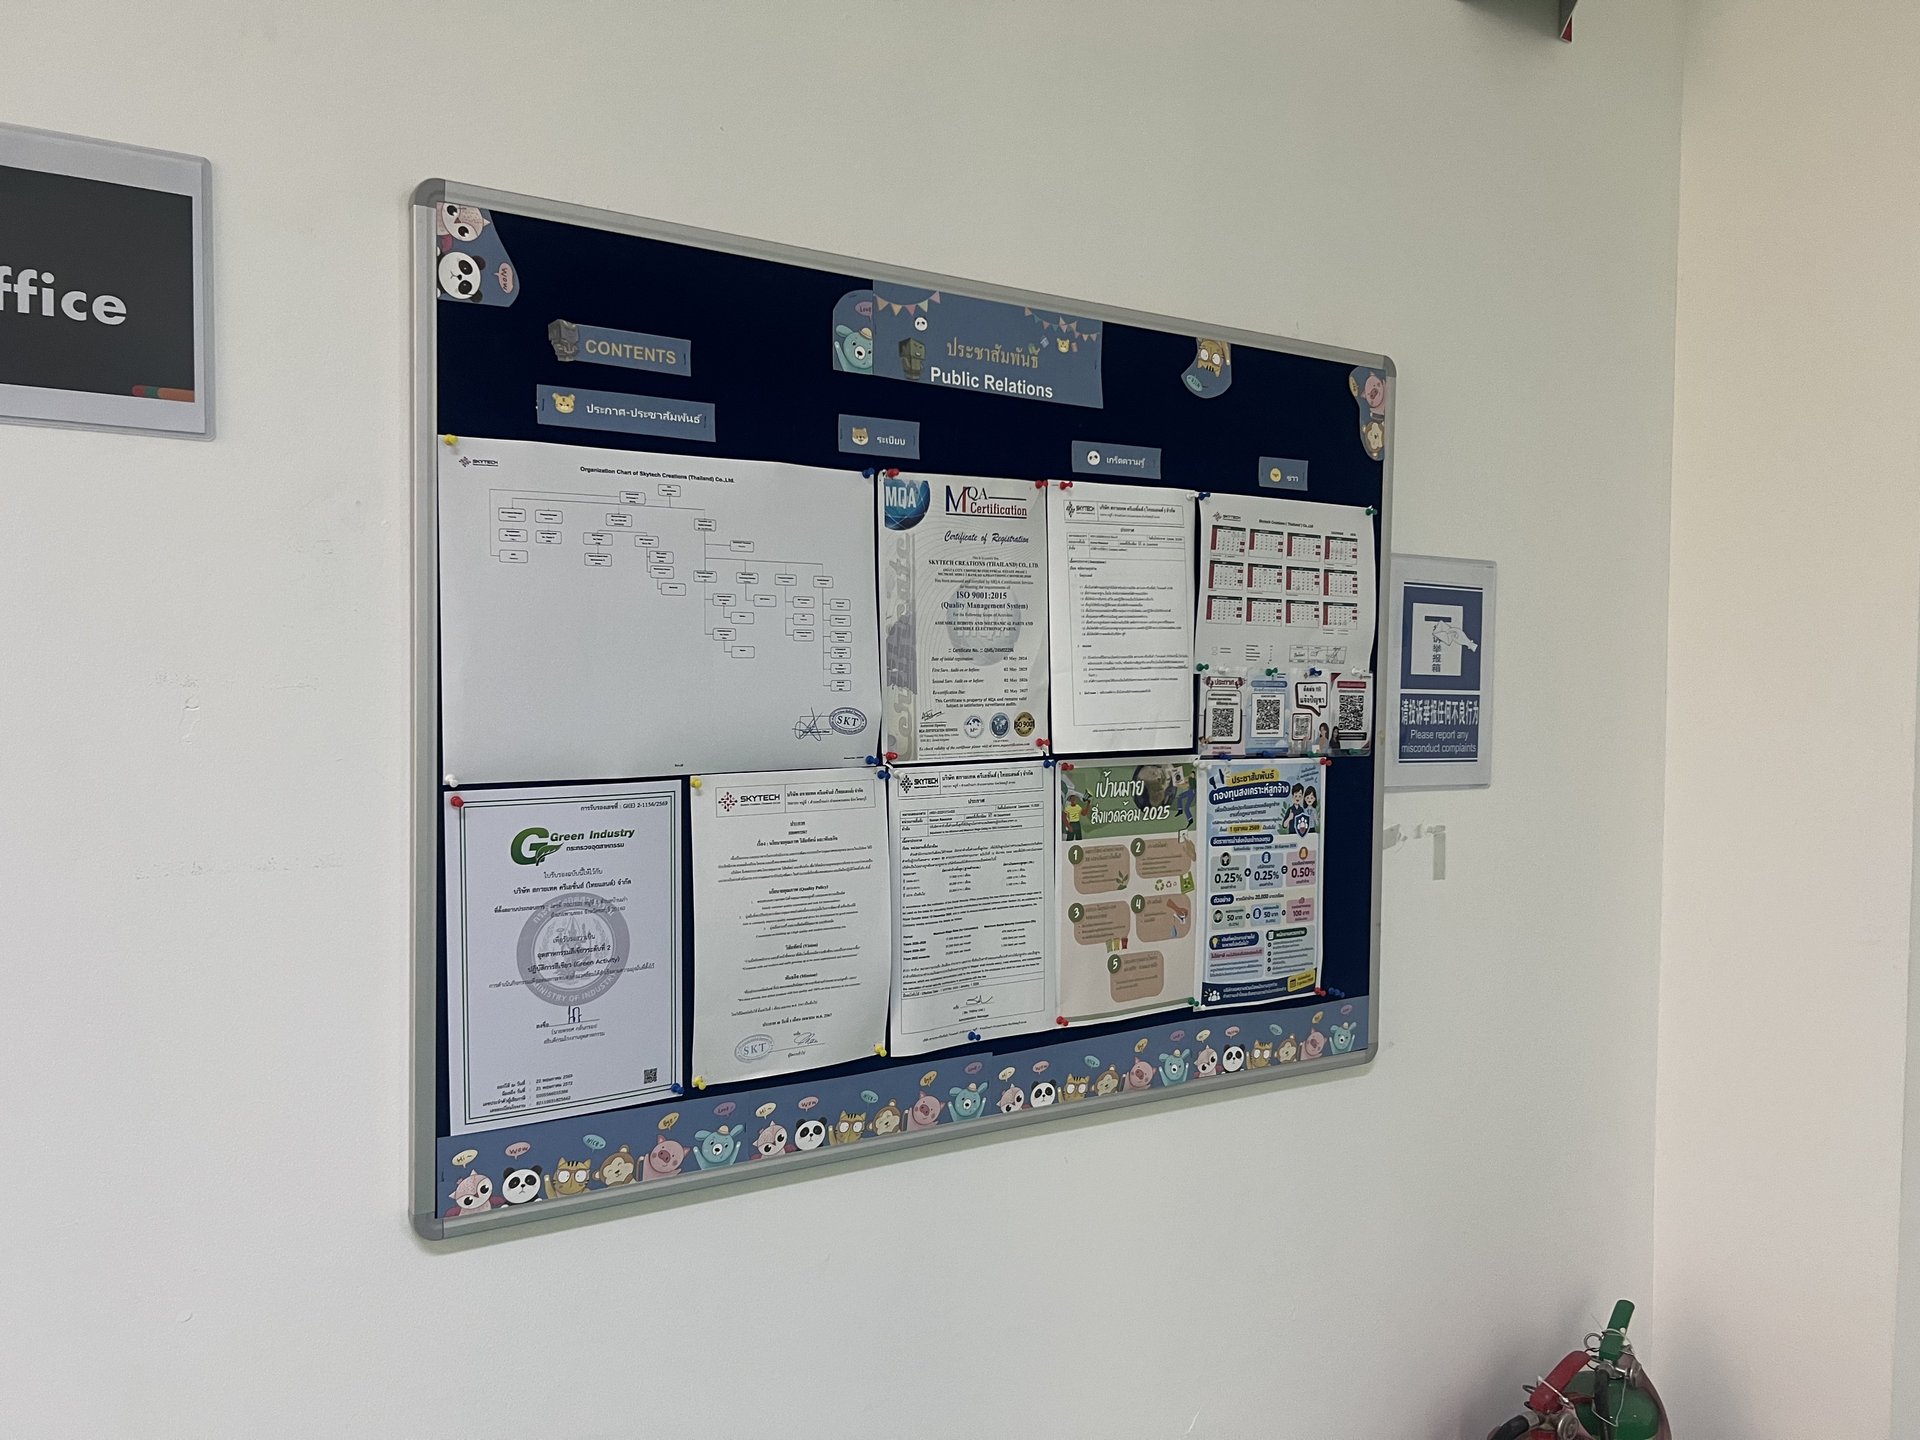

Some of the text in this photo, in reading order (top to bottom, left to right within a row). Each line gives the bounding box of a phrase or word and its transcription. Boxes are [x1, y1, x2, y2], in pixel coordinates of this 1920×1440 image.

[584, 338, 677, 366] CONTENTS
[946, 336, 1040, 369] ประชาสัมพันธ์
[930, 366, 1054, 399] Public Relations
[586, 402, 703, 425] ประกาศ-ประชาสัมพันธ์
[580, 466, 616, 474] Organization
[640, 470, 661, 479] Skytech
[688, 474, 714, 482] (Thailand)
[885, 486, 917, 509] MQA
[945, 484, 988, 513] MQA
[970, 502, 1028, 516] Certification
[944, 530, 1030, 544] Certificate of Registration
[972, 591, 1008, 600] 9001:2015
[941, 602, 1028, 611] (Quality Management System)
[837, 715, 859, 727] SKT
[1410, 729, 1469, 741] Please report any
[1401, 742, 1476, 754] misconduct complaints
[1232, 770, 1275, 784] ประชาสัมพันธ์
[1096, 771, 1144, 798] เป้าหมาย
[740, 794, 780, 803] SKYTECH
[1091, 801, 1170, 825] สิ่งแวดล้อม 2025
[550, 828, 635, 842] Green Industry
[1214, 873, 1242, 884] 0.25%
[1254, 870, 1279, 880] 0.25%
[1291, 867, 1315, 878] 0.50%
[513, 884, 530, 894] บริษัท
[573, 960, 594, 968] (Green
[596, 956, 620, 965] Activity)
[570, 994, 579, 1002] OF
[743, 1044, 766, 1055] SKT
